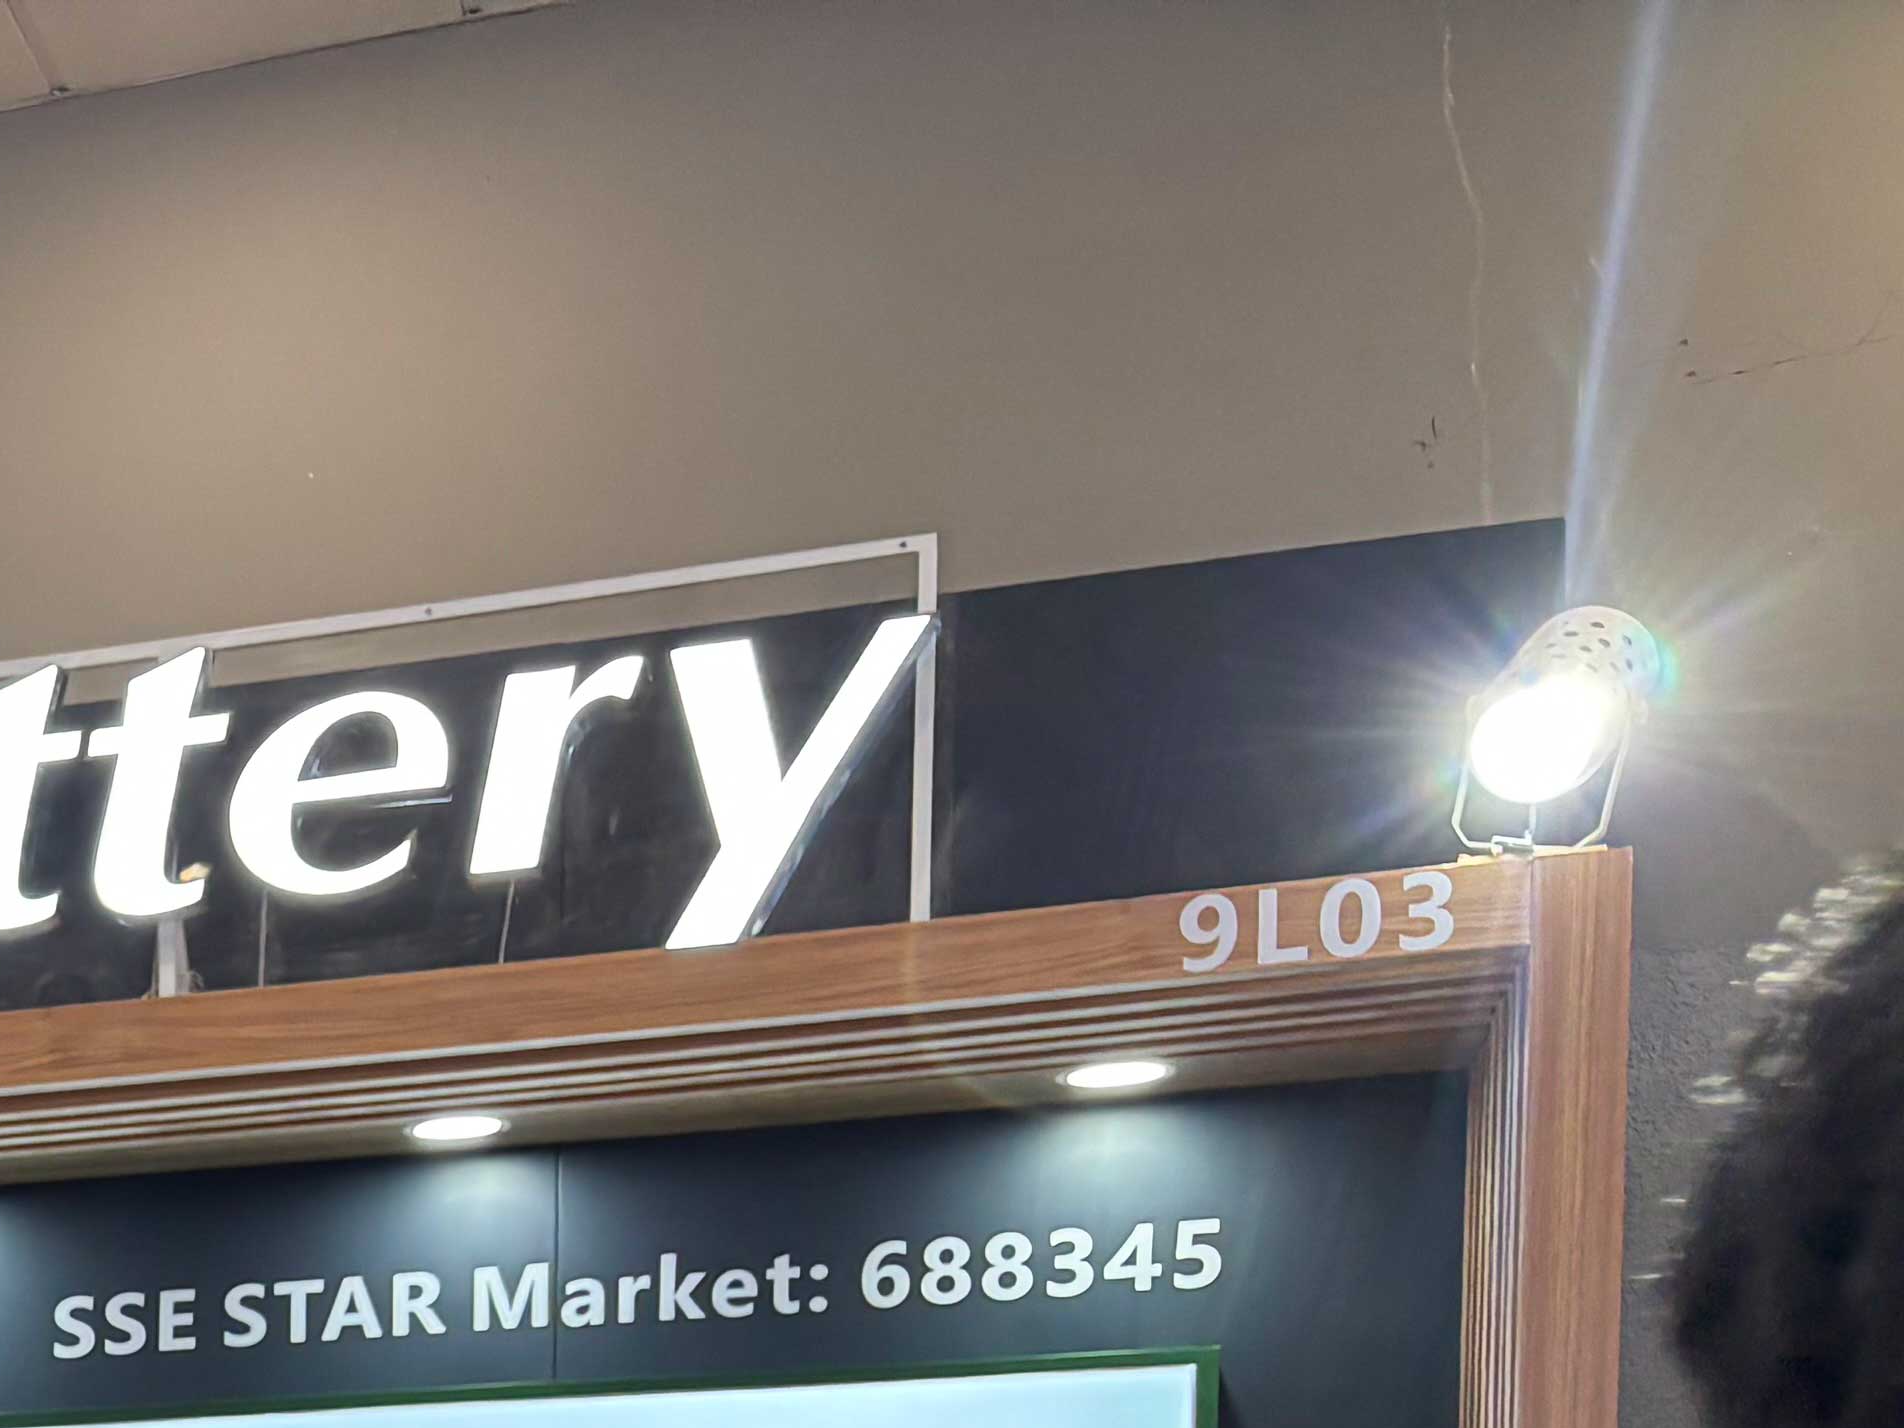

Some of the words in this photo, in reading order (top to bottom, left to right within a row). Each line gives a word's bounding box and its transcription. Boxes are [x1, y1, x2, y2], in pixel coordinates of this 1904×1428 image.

[1178, 870, 1455, 973] 9L03
[52, 1287, 197, 1361] SSE
[222, 1269, 442, 1349] STAR
[472, 1251, 830, 1333] Market:
[859, 1217, 1224, 1311] 688345
